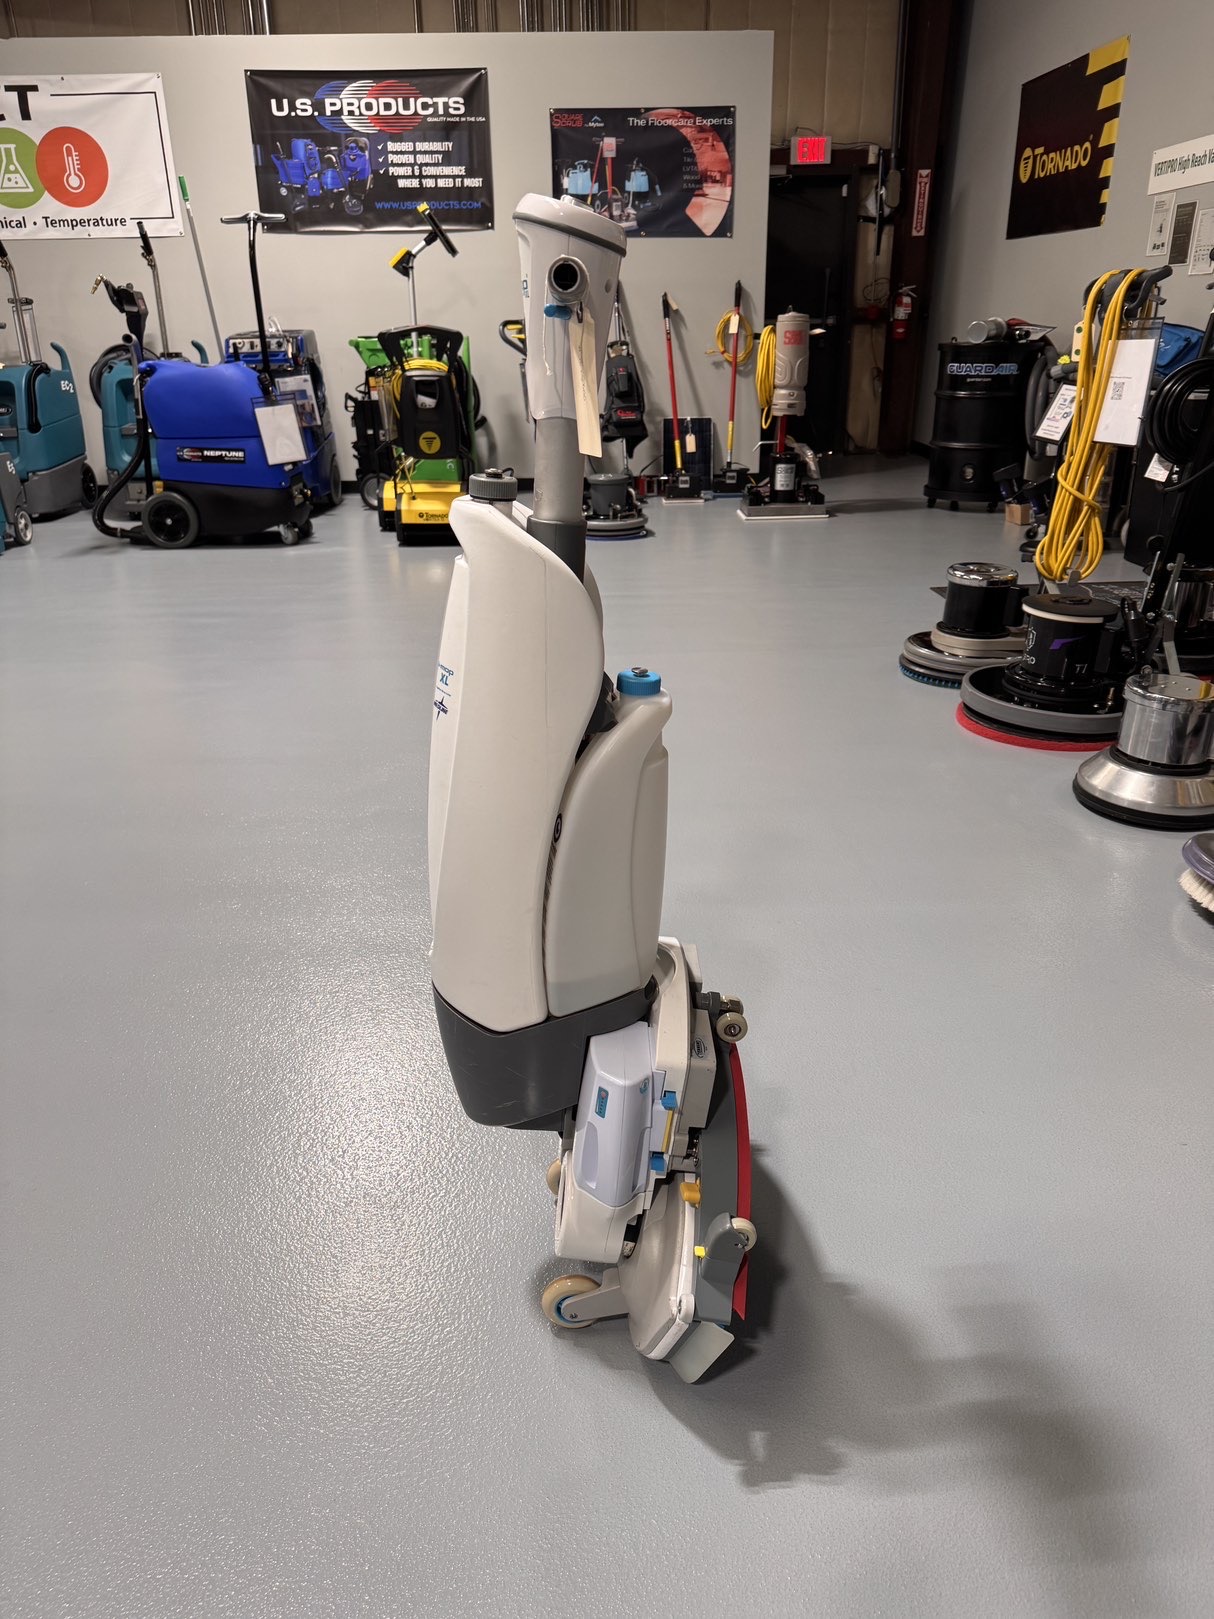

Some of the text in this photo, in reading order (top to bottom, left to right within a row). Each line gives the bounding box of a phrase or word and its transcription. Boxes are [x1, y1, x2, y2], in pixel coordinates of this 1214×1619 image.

[270, 97, 466, 117] U.S. PRODUCTS
[628, 117, 733, 127] The Floorcare Experts
[387, 141, 453, 152] RUGGED DURABILITY
[797, 137, 827, 163] EXIT
[388, 153, 443, 164] PROVEN QUALITY
[1034, 141, 1092, 179] TORNADO
[1190, 149, 1208, 168] Reach
[388, 166, 466, 176] POWER & CONVENIENCE
[397, 178, 483, 188] WHERE YOU NEED IT MOST
[375, 201, 481, 210] WWW.USPDUCTS.COM
[42, 216, 127, 230] Temperature
[947, 363, 1020, 375] GUARDAIR
[203, 450, 245, 458] NEPTUNE
[439, 672, 449, 686] XL
